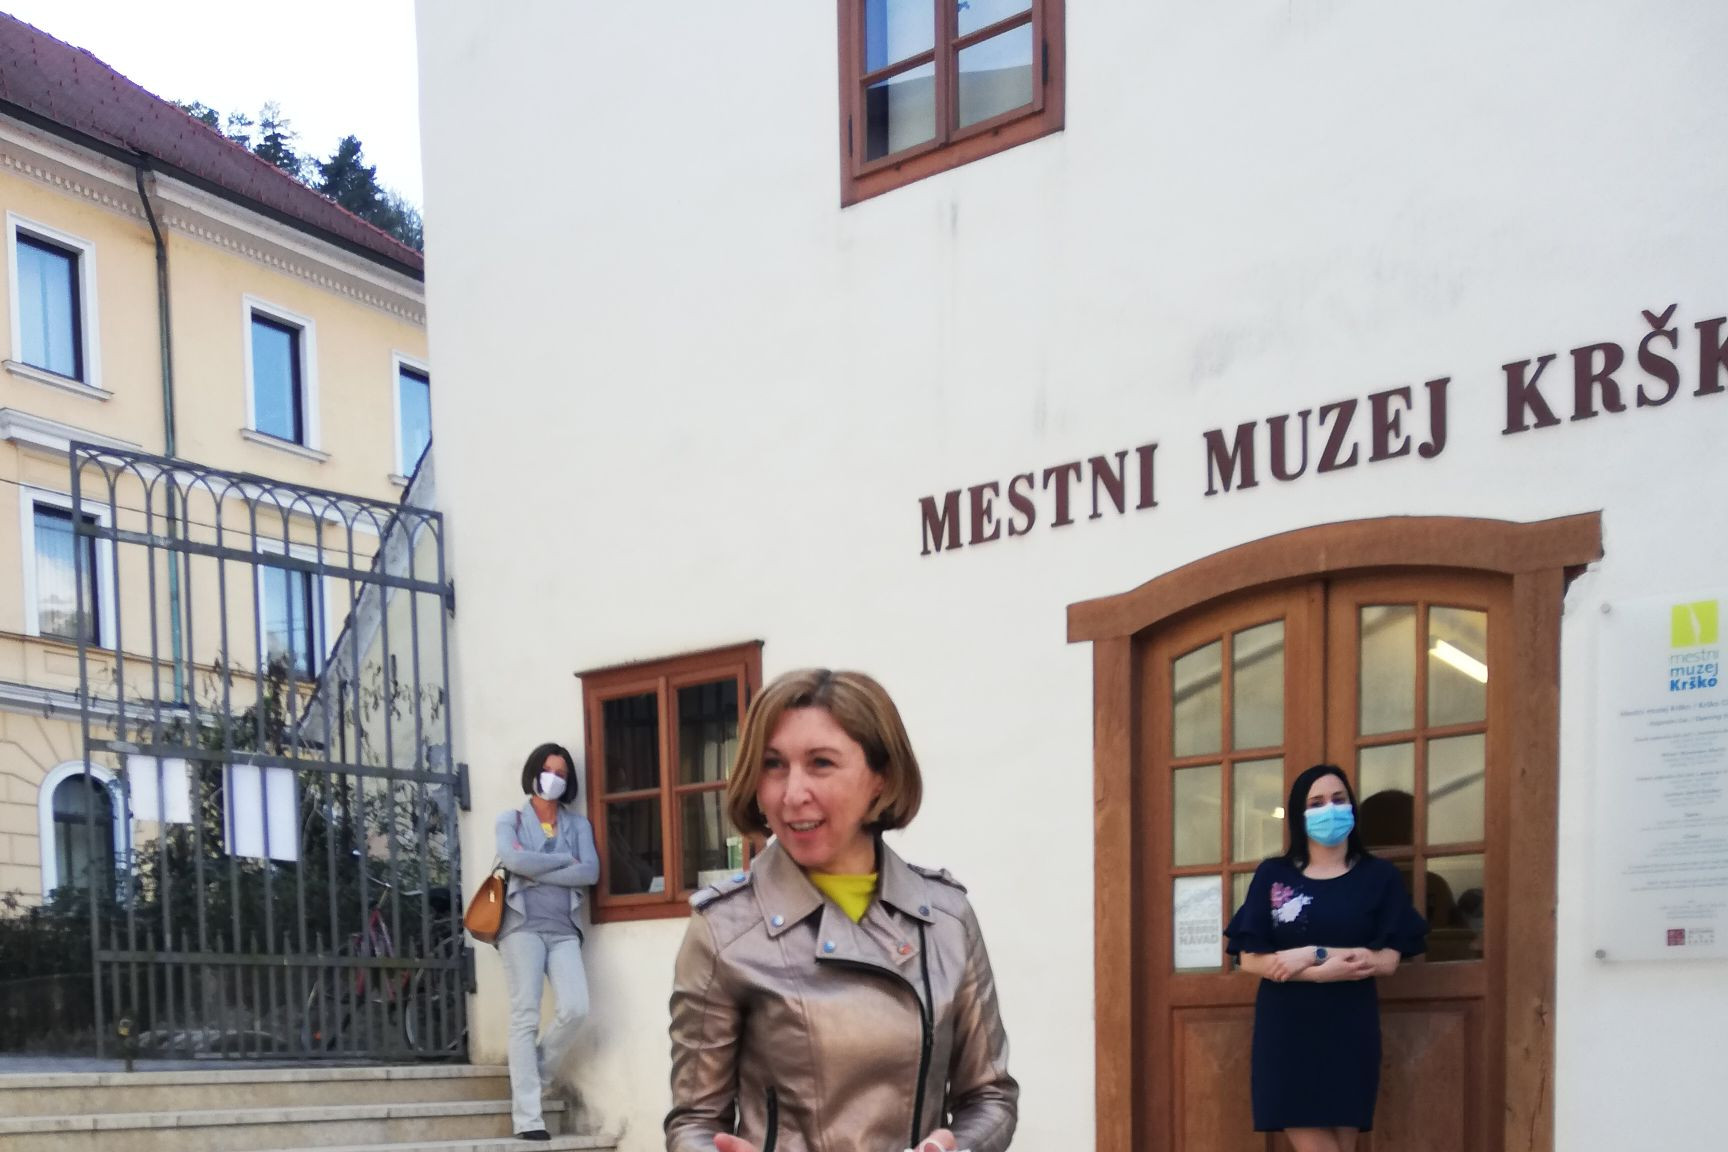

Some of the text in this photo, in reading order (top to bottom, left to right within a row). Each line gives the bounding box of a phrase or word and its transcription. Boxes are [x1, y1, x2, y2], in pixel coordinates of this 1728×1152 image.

[918, 443, 1159, 556] MESTNI
[1203, 376, 1452, 496] MUZEJ
[1669, 662, 1718, 677] muzej
[1669, 675, 1718, 692] Krško
